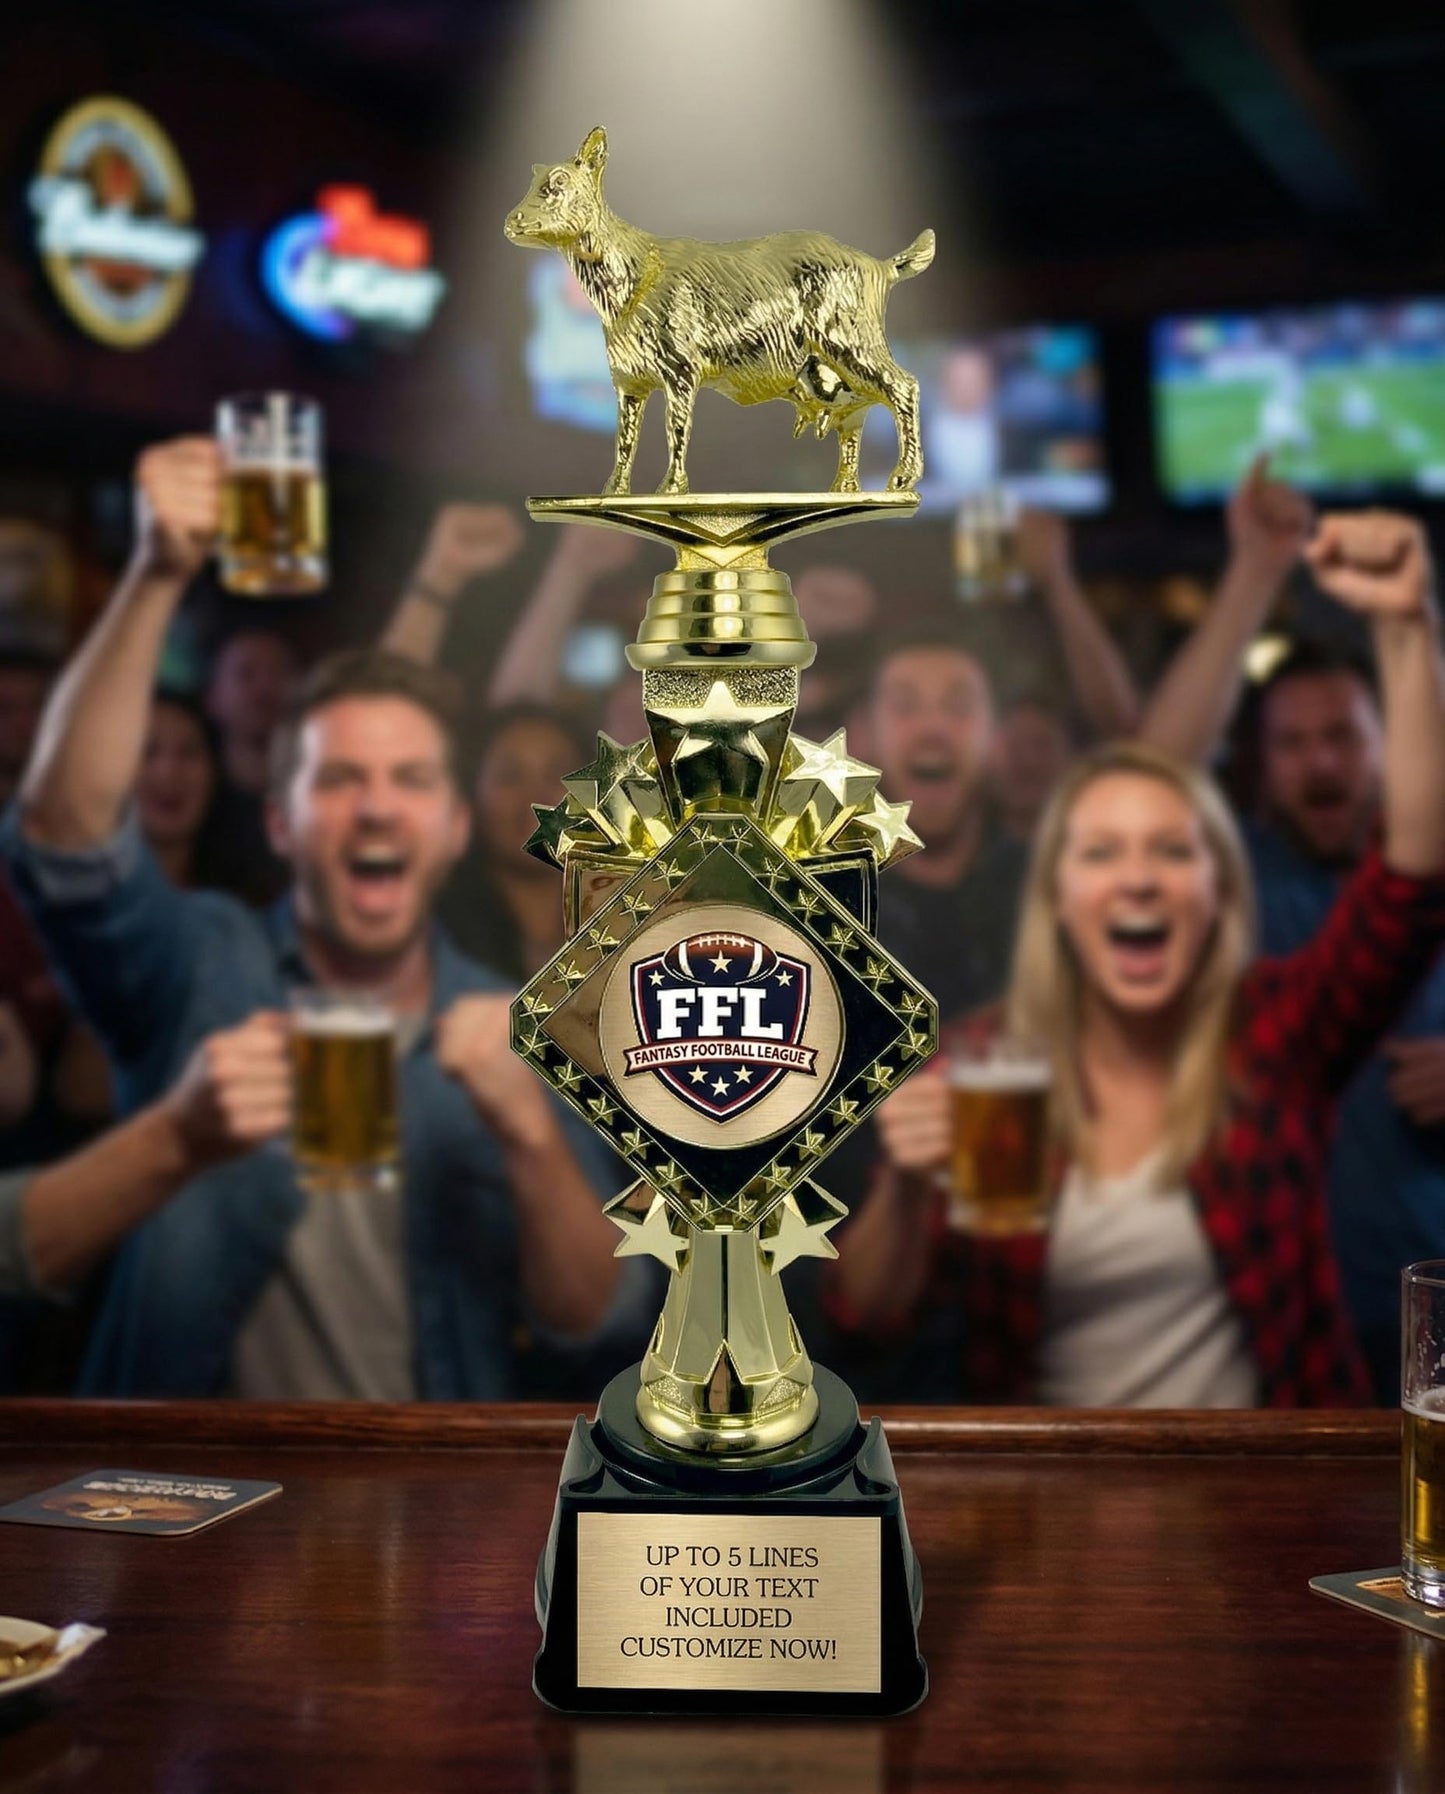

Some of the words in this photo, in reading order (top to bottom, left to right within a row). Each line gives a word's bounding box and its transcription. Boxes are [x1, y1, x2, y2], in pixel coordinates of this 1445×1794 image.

[657, 987, 783, 1040] FFL
[634, 1044, 689, 1065] FANTASY
[691, 1043, 755, 1057] FOOTBALL
[757, 1048, 806, 1064] LEAGUE
[646, 1545, 679, 1566] UP
[686, 1546, 721, 1567] TO
[728, 1547, 742, 1567] 5
[749, 1547, 819, 1568] LINES
[640, 1576, 673, 1597] OF
[679, 1577, 750, 1597] YOUR
[755, 1578, 819, 1598] TEXT
[666, 1607, 793, 1628] INCLUDED
[620, 1637, 763, 1659] CUSTOMIZE
[770, 1639, 837, 1660] NOW!
